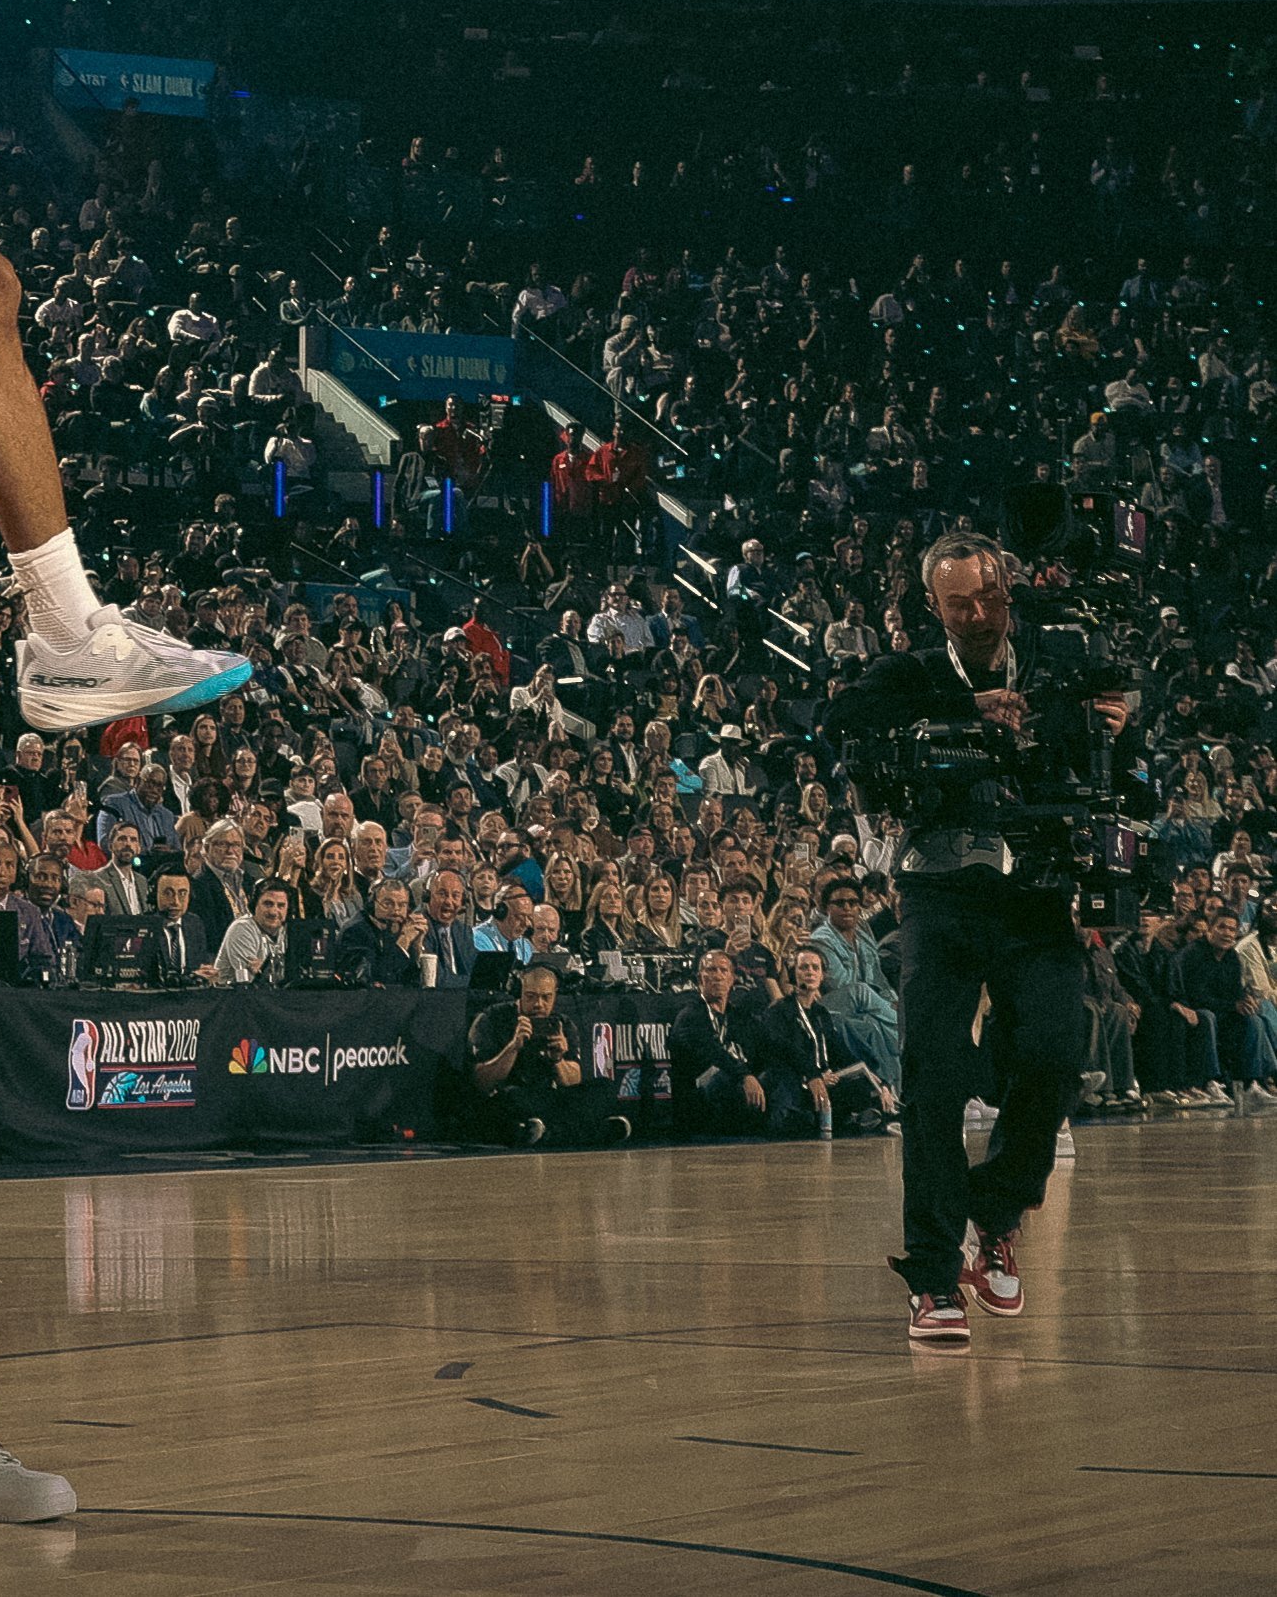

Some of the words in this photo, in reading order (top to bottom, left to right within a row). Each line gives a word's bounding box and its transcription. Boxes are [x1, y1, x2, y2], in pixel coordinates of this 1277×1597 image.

[132, 72, 162, 95] SLAM
[164, 75, 194, 98] DUNK
[421, 354, 455, 380] SLAM
[457, 356, 491, 382] DUNK
[168, 1018, 201, 1063] 2026
[615, 1023, 635, 1062] ALL
[269, 1046, 321, 1075] NBC
[332, 1035, 410, 1083] peacock
[131, 1074, 150, 1096] Los
[151, 1072, 194, 1102] Angeles
